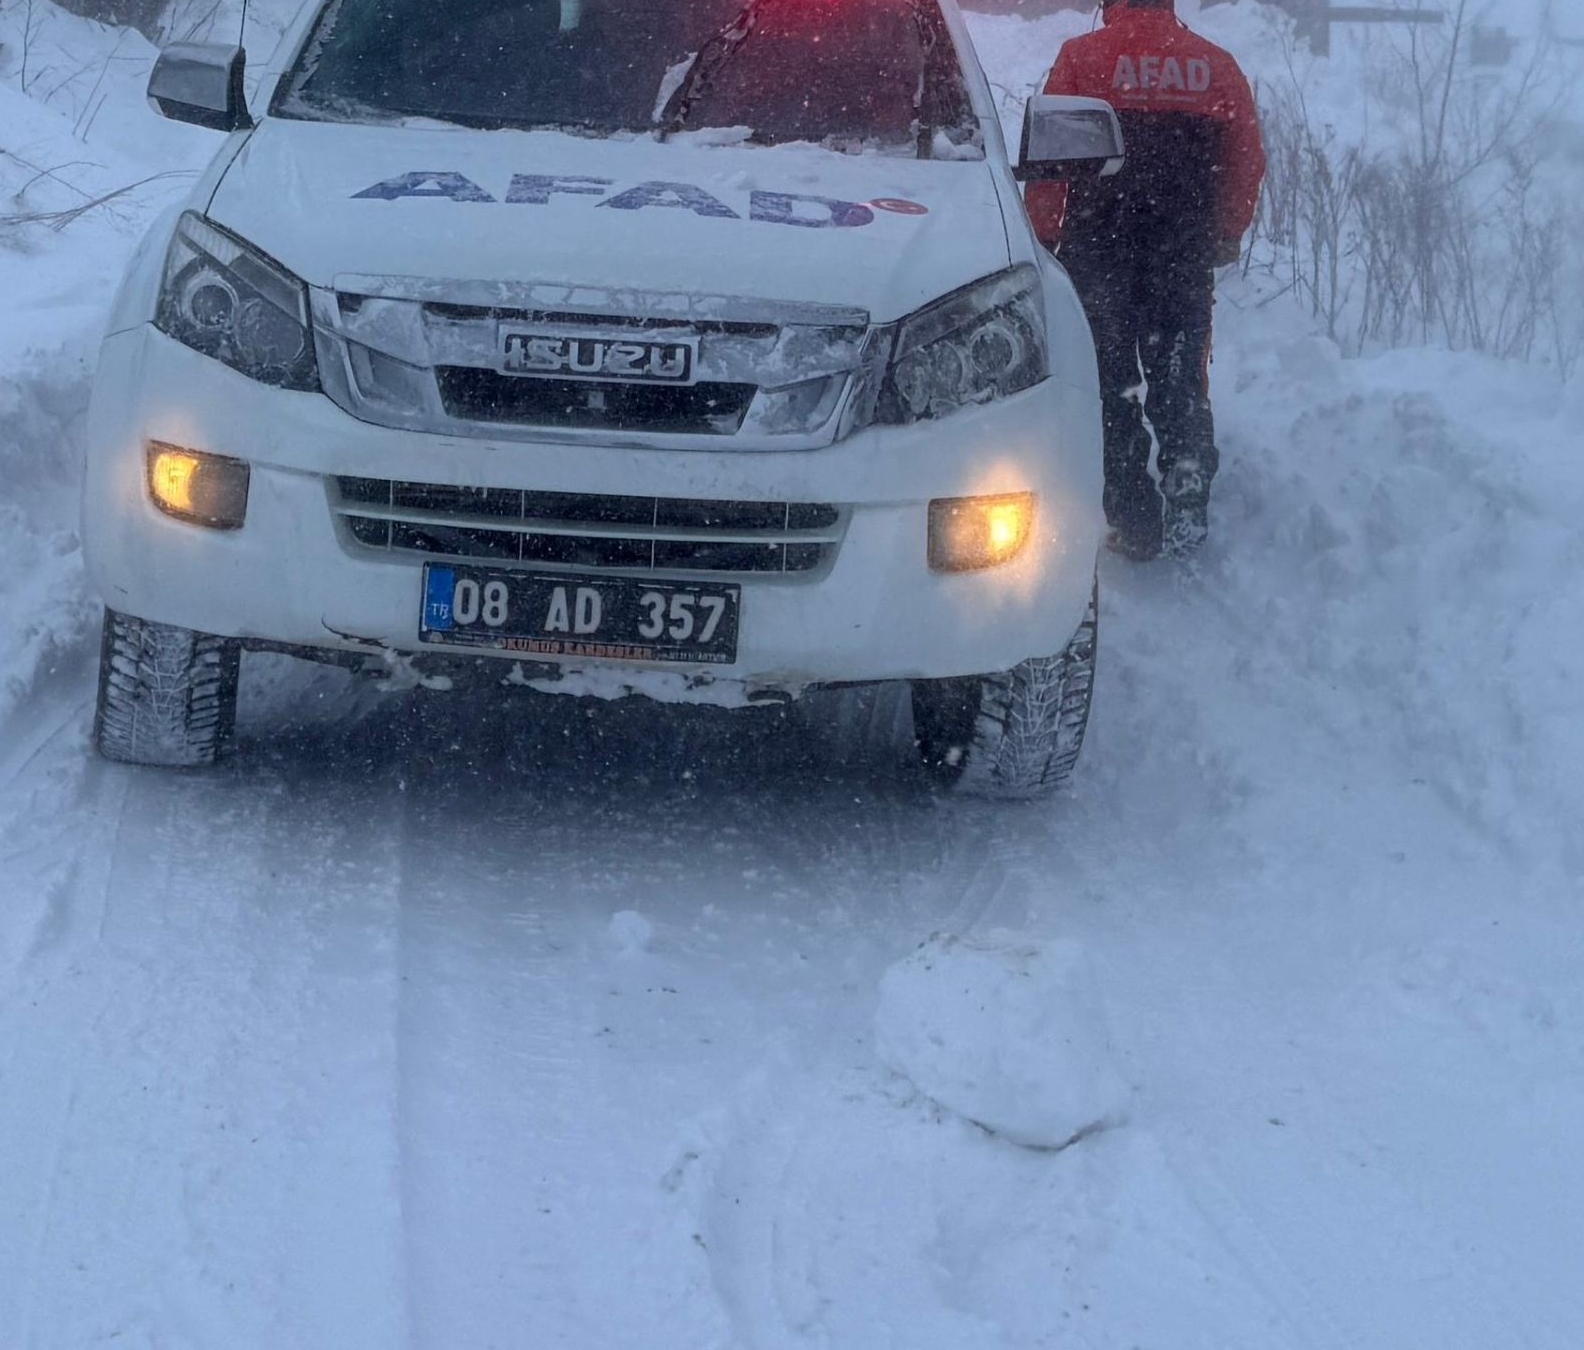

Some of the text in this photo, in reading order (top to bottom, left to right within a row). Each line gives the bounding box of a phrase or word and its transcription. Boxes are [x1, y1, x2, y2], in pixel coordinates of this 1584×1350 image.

[1112, 54, 1210, 92] AFAD
[350, 170, 875, 229] AFAD
[510, 337, 686, 378] ISUZU
[430, 578, 726, 643] TR 08 AD 357
